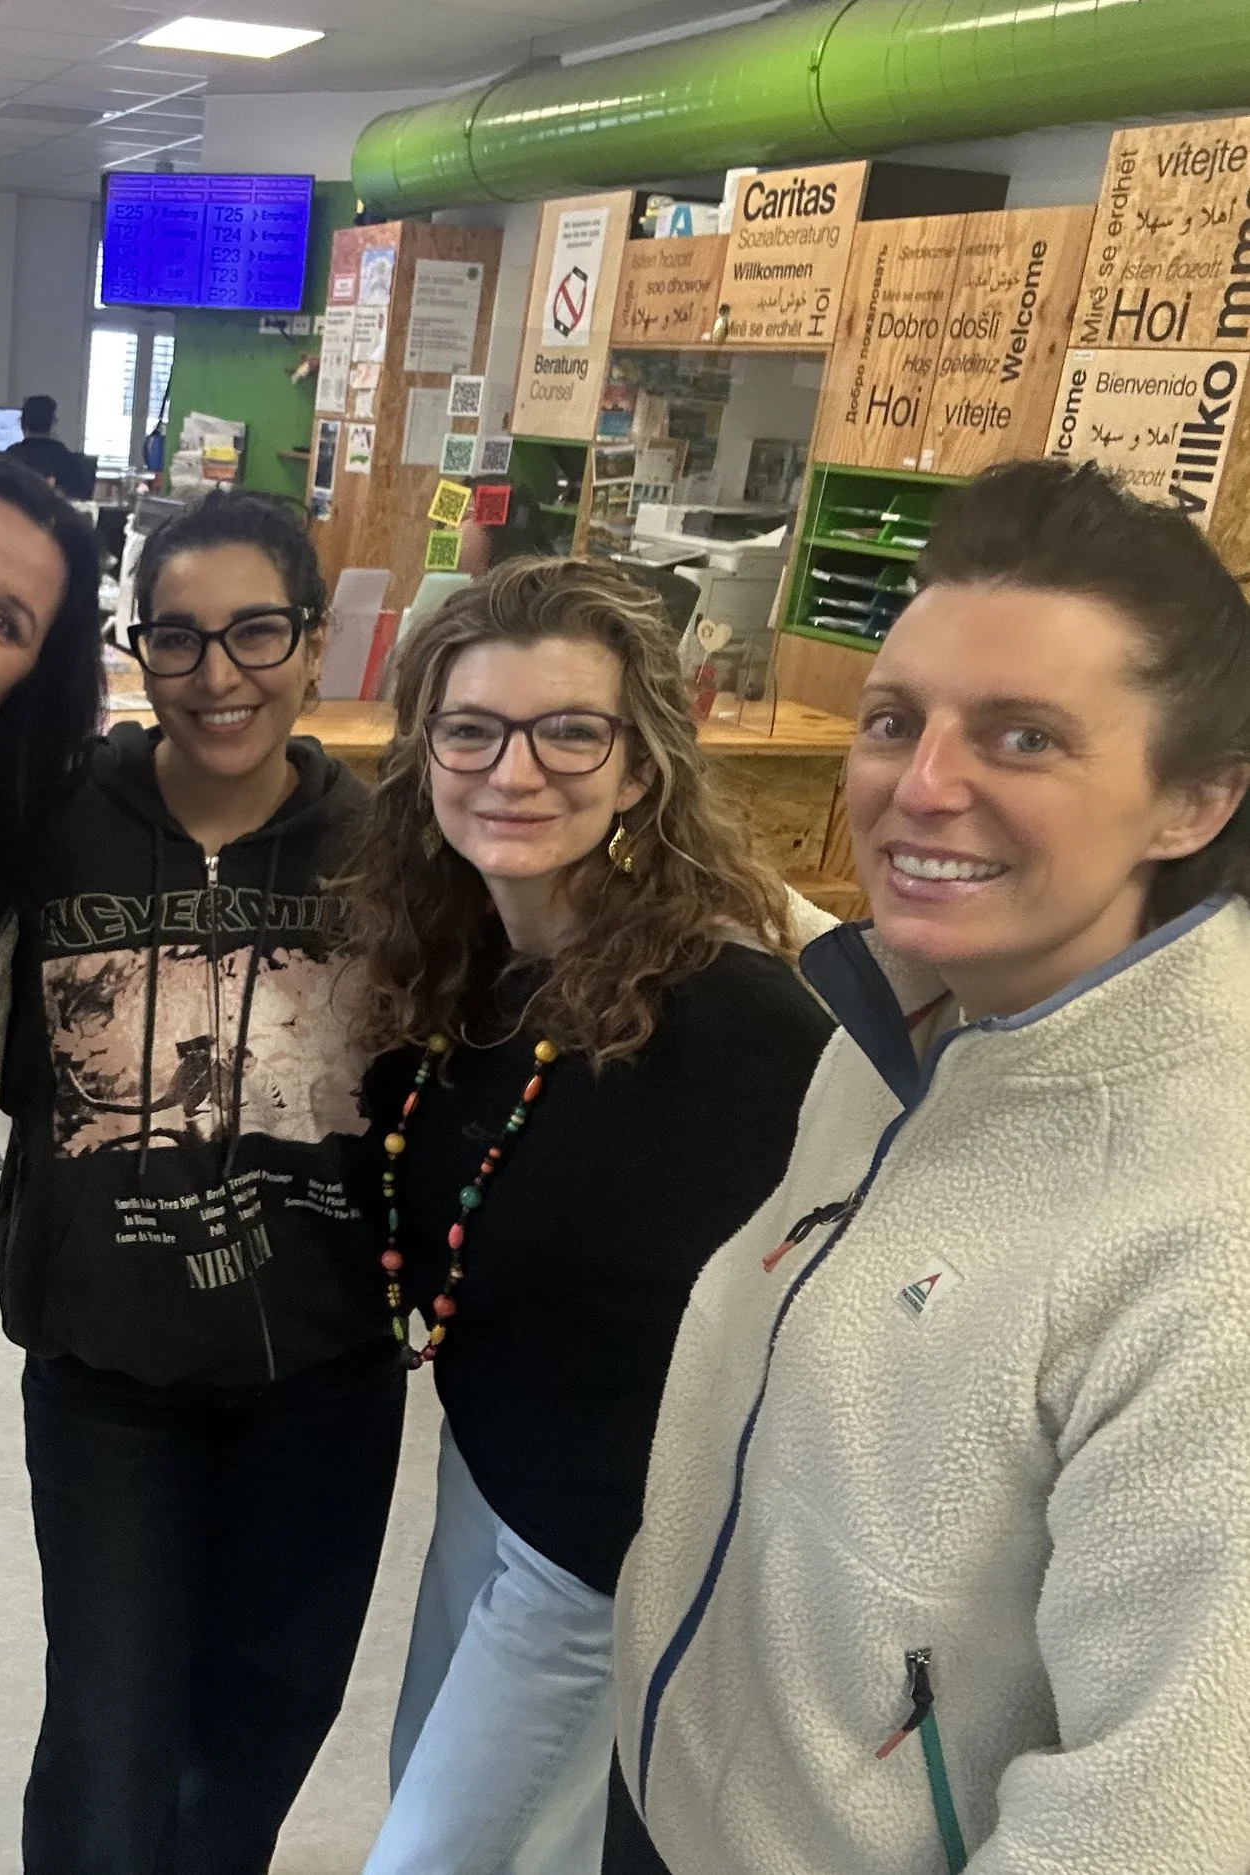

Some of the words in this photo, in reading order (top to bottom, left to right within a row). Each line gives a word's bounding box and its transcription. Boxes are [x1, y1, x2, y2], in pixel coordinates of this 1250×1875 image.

[1158, 139, 1248, 184] vítejte
[116, 204, 144, 220] E25
[743, 176, 838, 222] Caritas
[215, 206, 244, 223] T25
[213, 226, 241, 242] T24
[738, 224, 840, 250] Sozialberatung
[211, 247, 240, 264] E23
[1101, 246, 1117, 277] se
[1216, 187, 1250, 339] mm
[209, 267, 238, 283] T23
[734, 262, 813, 281] Willkommen
[208, 286, 237, 303] E22
[1001, 239, 1047, 385] Welcome
[1107, 288, 1192, 342] Hoi
[750, 322, 763, 338] se
[878, 312, 939, 340] Dobro
[950, 311, 1002, 340] došli
[534, 354, 589, 380] Beratung
[531, 379, 575, 401] Counsel
[1096, 372, 1198, 397] Bienvenido
[866, 384, 922, 428] Hoi
[945, 399, 1012, 434] vítejte
[1052, 368, 1087, 457] lcome
